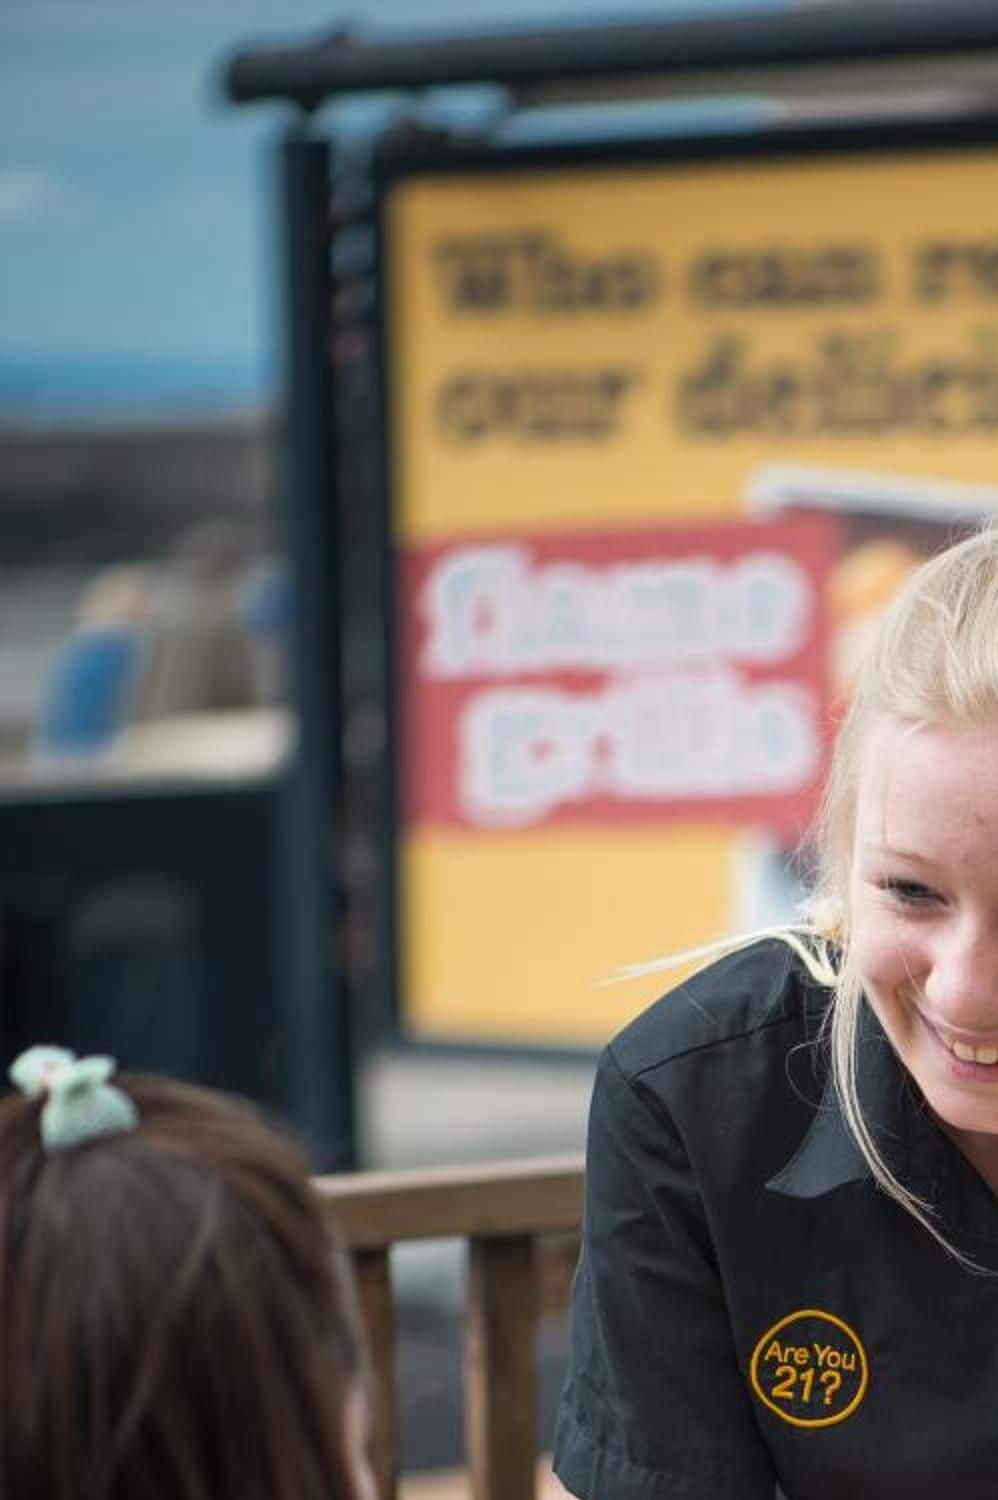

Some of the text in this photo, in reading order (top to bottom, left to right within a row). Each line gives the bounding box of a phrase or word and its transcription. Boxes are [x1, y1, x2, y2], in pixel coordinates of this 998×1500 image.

[433, 228, 660, 316] Who
[688, 244, 880, 312] can
[435, 364, 638, 446] our
[764, 1340, 856, 1371] Are You
[771, 1365, 843, 1405] 21?
